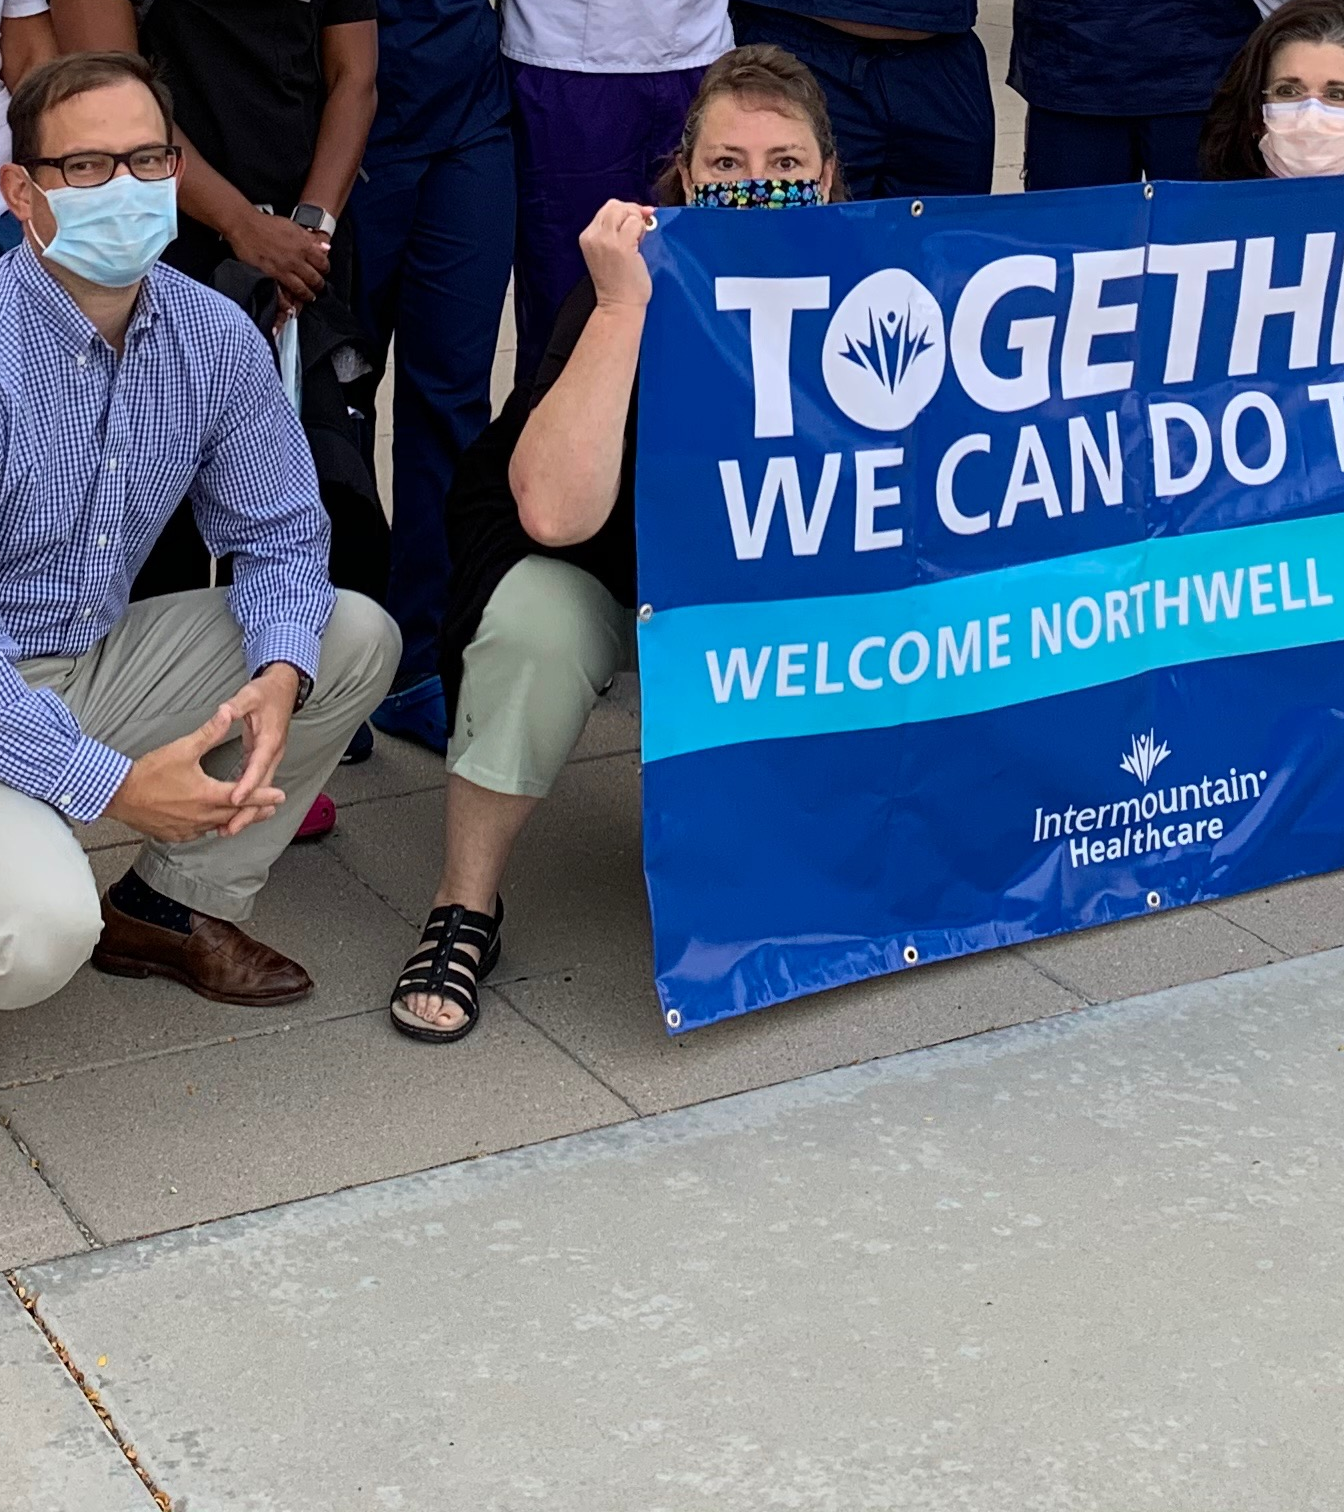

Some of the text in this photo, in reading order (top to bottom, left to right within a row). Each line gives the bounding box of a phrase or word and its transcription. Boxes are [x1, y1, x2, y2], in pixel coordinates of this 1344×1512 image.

[718, 447, 905, 560] WE
[935, 410, 1124, 535] CAN
[1148, 390, 1288, 497] DO
[705, 613, 1011, 704] WELCOME
[1030, 557, 1334, 660] NORTHWELL
[1032, 767, 1262, 843] Intermountain
[1068, 816, 1224, 868] Healthcare
